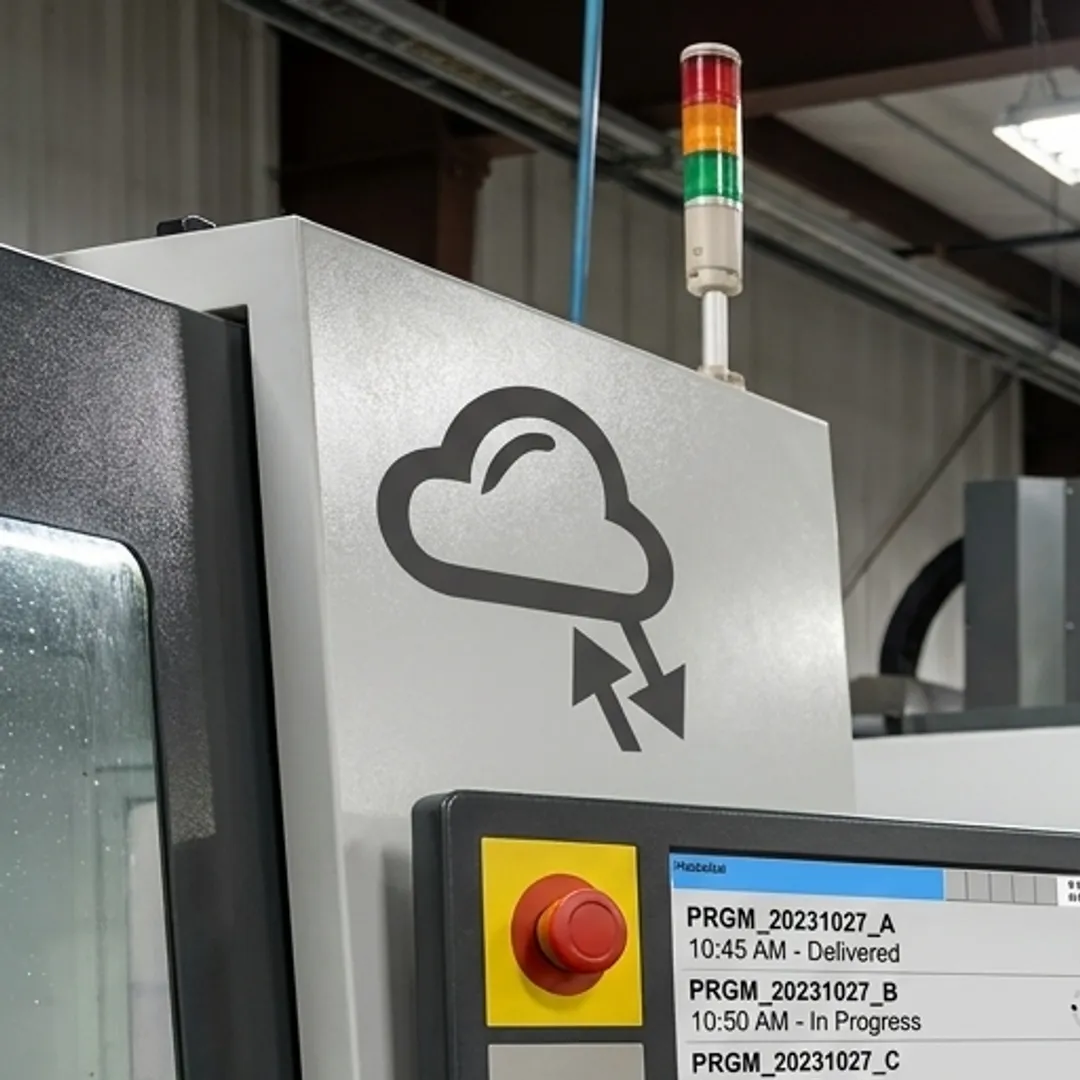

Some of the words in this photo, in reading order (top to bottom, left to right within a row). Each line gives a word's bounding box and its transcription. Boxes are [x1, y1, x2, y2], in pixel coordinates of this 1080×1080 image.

[687, 906, 896, 938] PRGM_20231027_A
[689, 938, 748, 960] 10:45
[752, 940, 787, 960] AM
[807, 941, 900, 963] Delivered
[689, 979, 898, 1007] PRGM_20231027_B
[691, 1010, 750, 1032] 10:50
[754, 1011, 789, 1032] AM
[810, 1010, 829, 1031] In
[835, 1010, 922, 1036] Progress
[691, 1050, 900, 1078] PRGM_20231027_C
